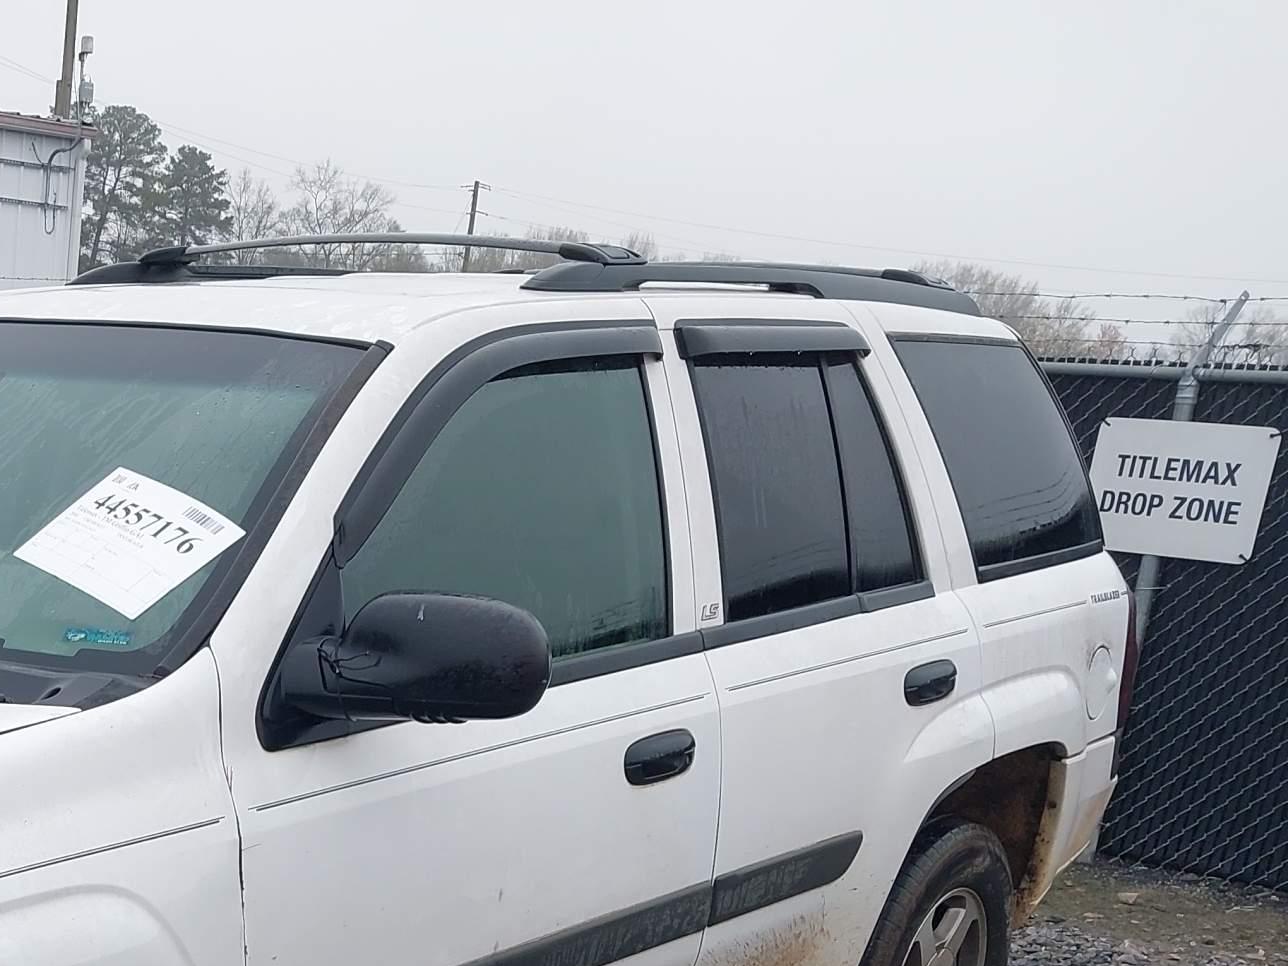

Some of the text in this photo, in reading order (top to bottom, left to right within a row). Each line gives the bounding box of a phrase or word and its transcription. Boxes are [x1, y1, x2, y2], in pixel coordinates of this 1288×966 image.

[1117, 453, 1242, 487] TITLEMAX
[94, 494, 203, 554] 44557176
[1099, 490, 1242, 525] DROP ZONE
[700, 602, 720, 622] LS
